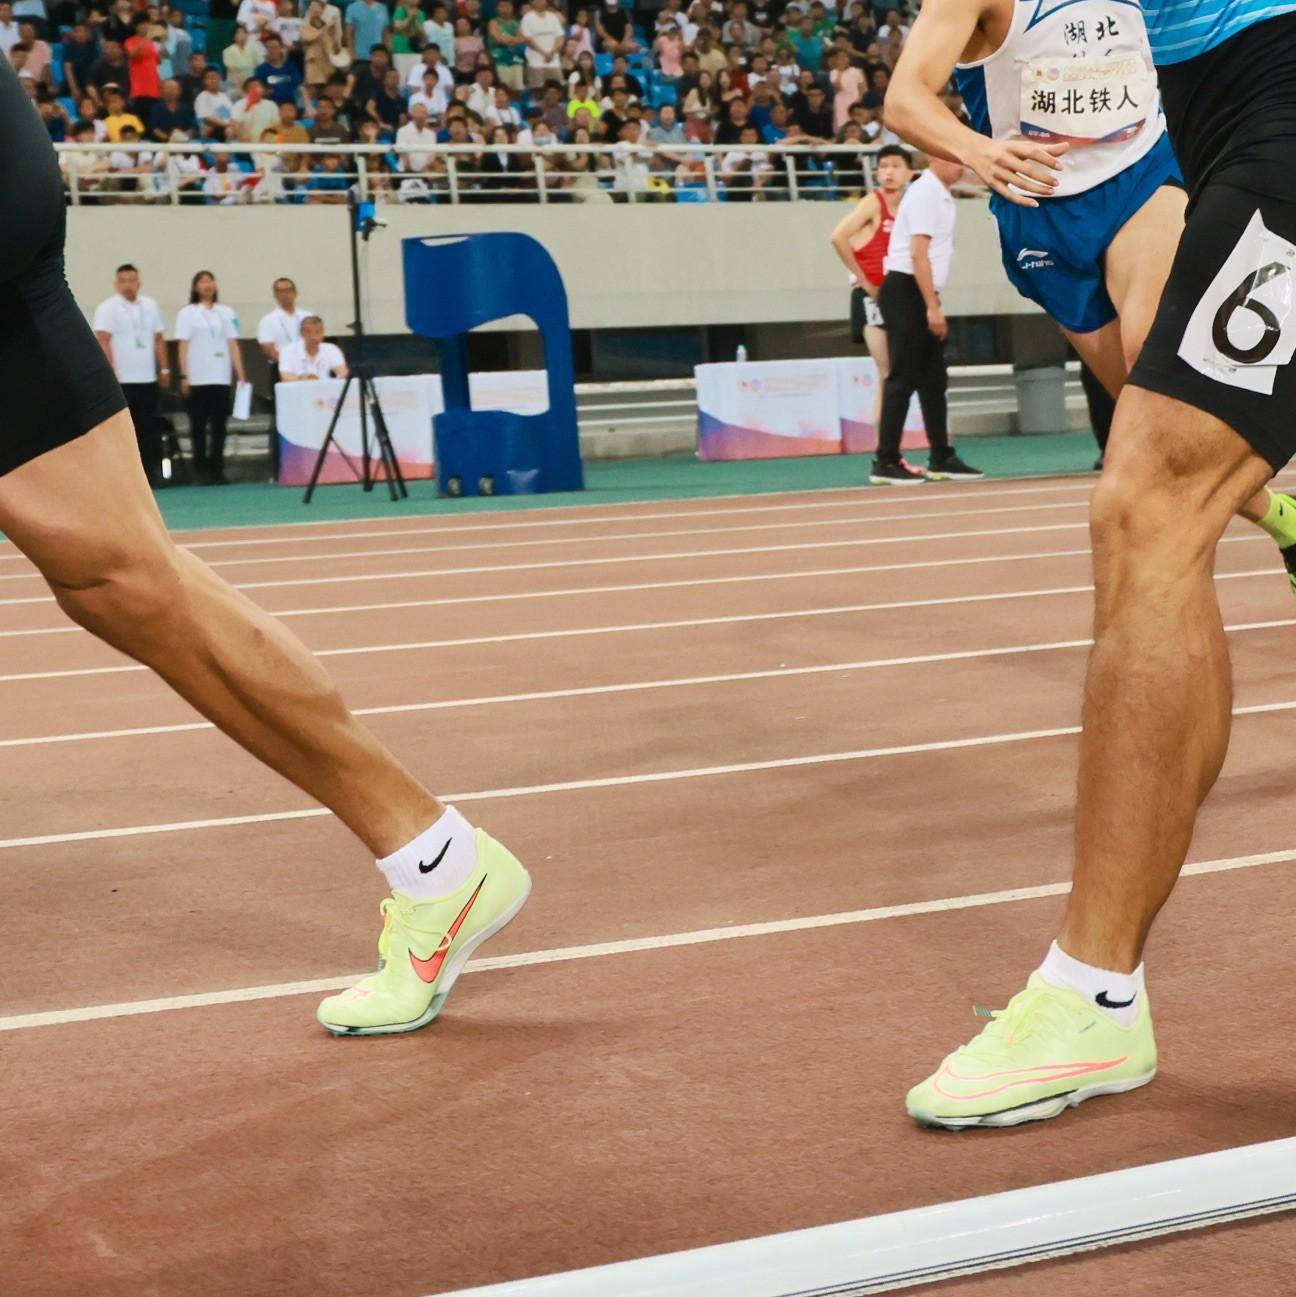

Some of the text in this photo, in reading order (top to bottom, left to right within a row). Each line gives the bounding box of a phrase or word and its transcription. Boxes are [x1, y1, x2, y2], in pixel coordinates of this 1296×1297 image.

[1064, 16, 1120, 46] 湖北
[1031, 85, 1139, 115] 湖北铁人
[1211, 261, 1291, 364] 6
